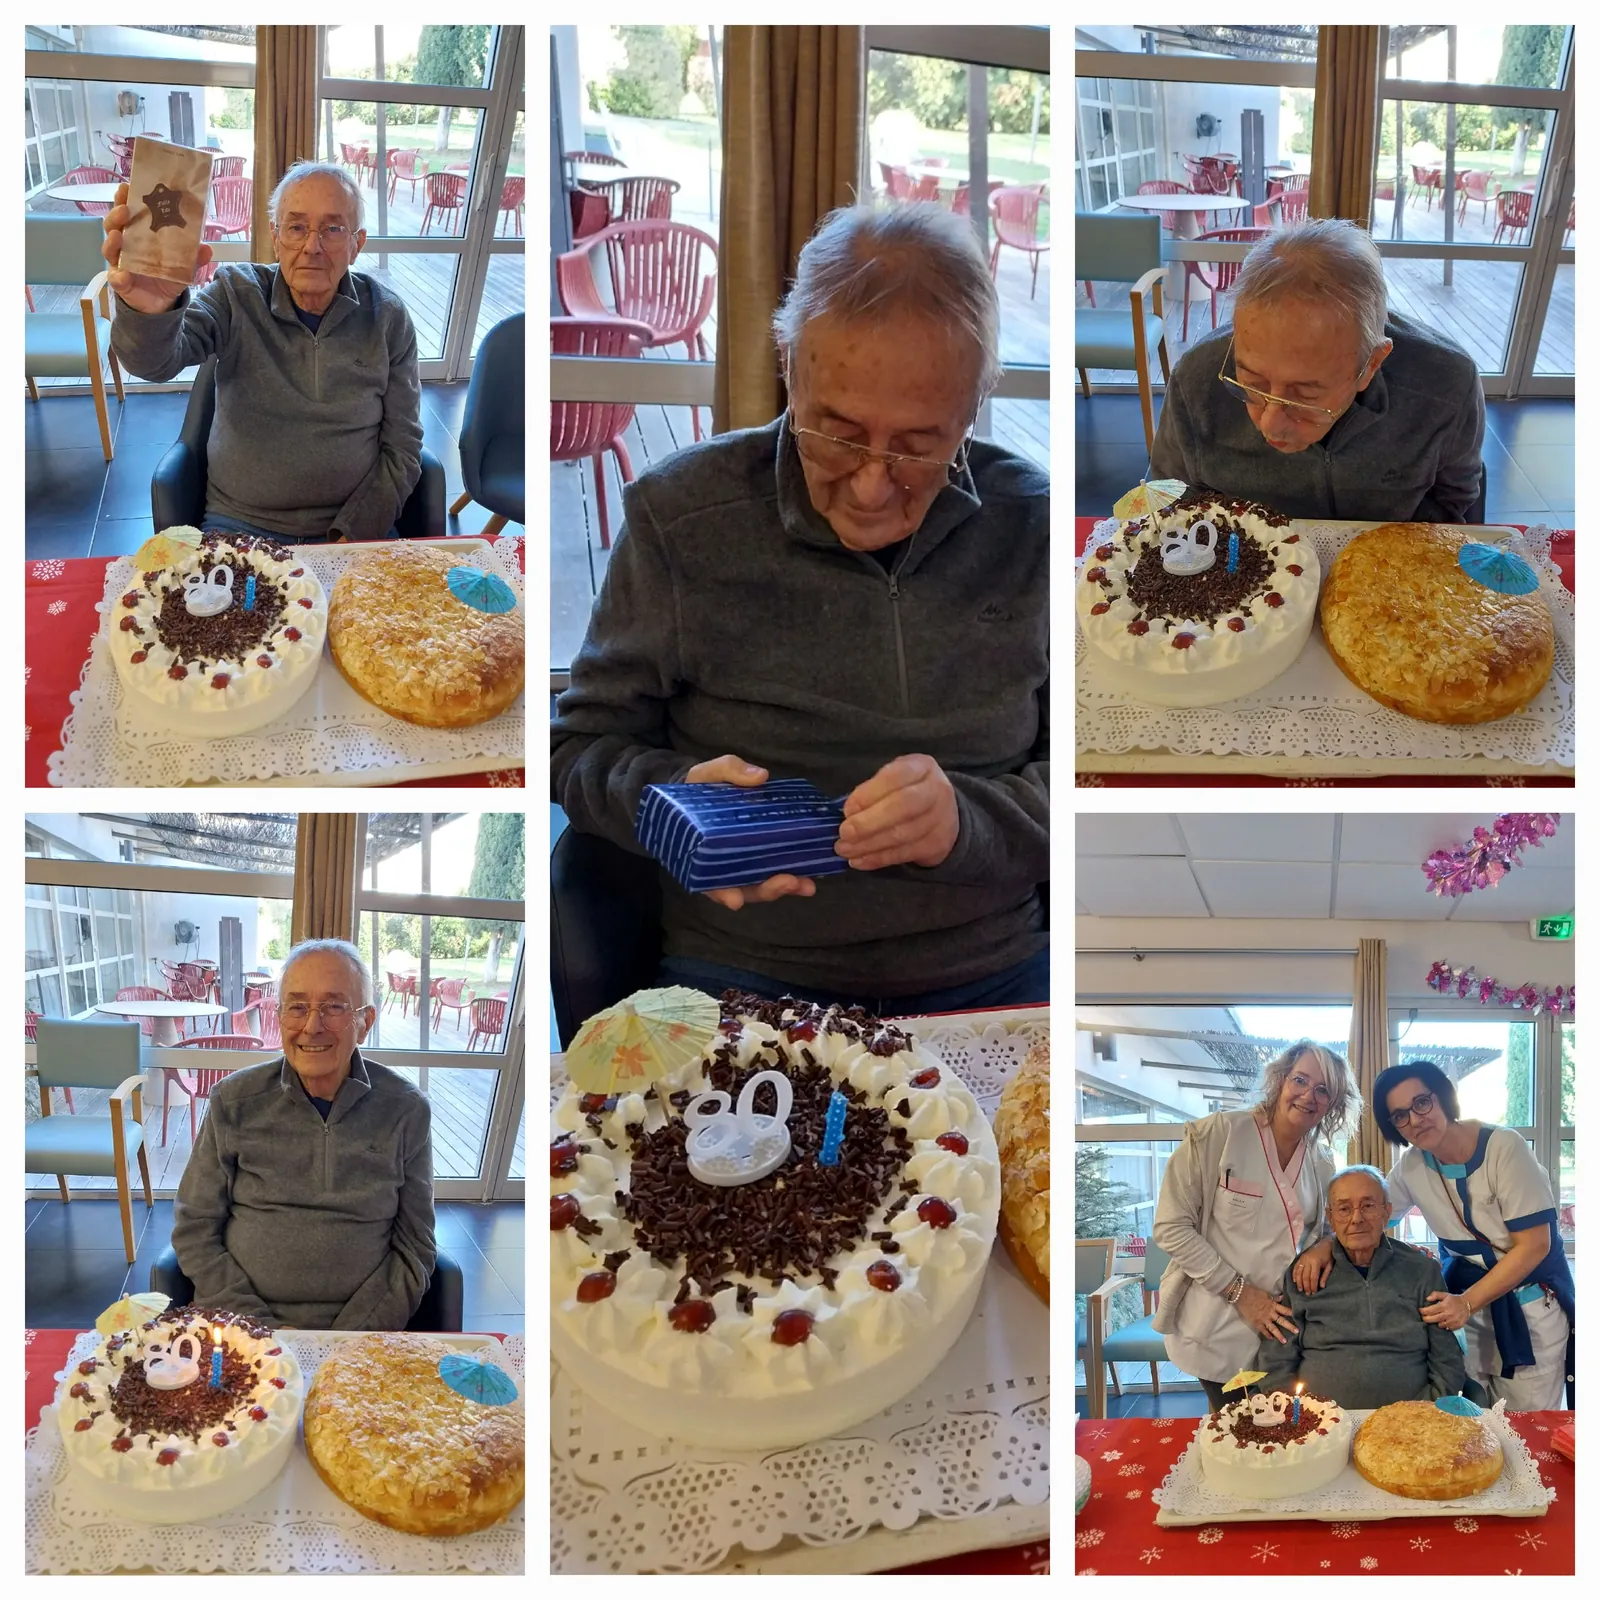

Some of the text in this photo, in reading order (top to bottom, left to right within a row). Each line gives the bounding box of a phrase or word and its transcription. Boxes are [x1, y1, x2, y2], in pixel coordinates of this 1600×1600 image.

[1159, 520, 1218, 561] 80
[183, 564, 234, 602] 80
[684, 1069, 793, 1157] 80
[143, 1334, 201, 1376] 80
[1251, 1391, 1287, 1417] 80
